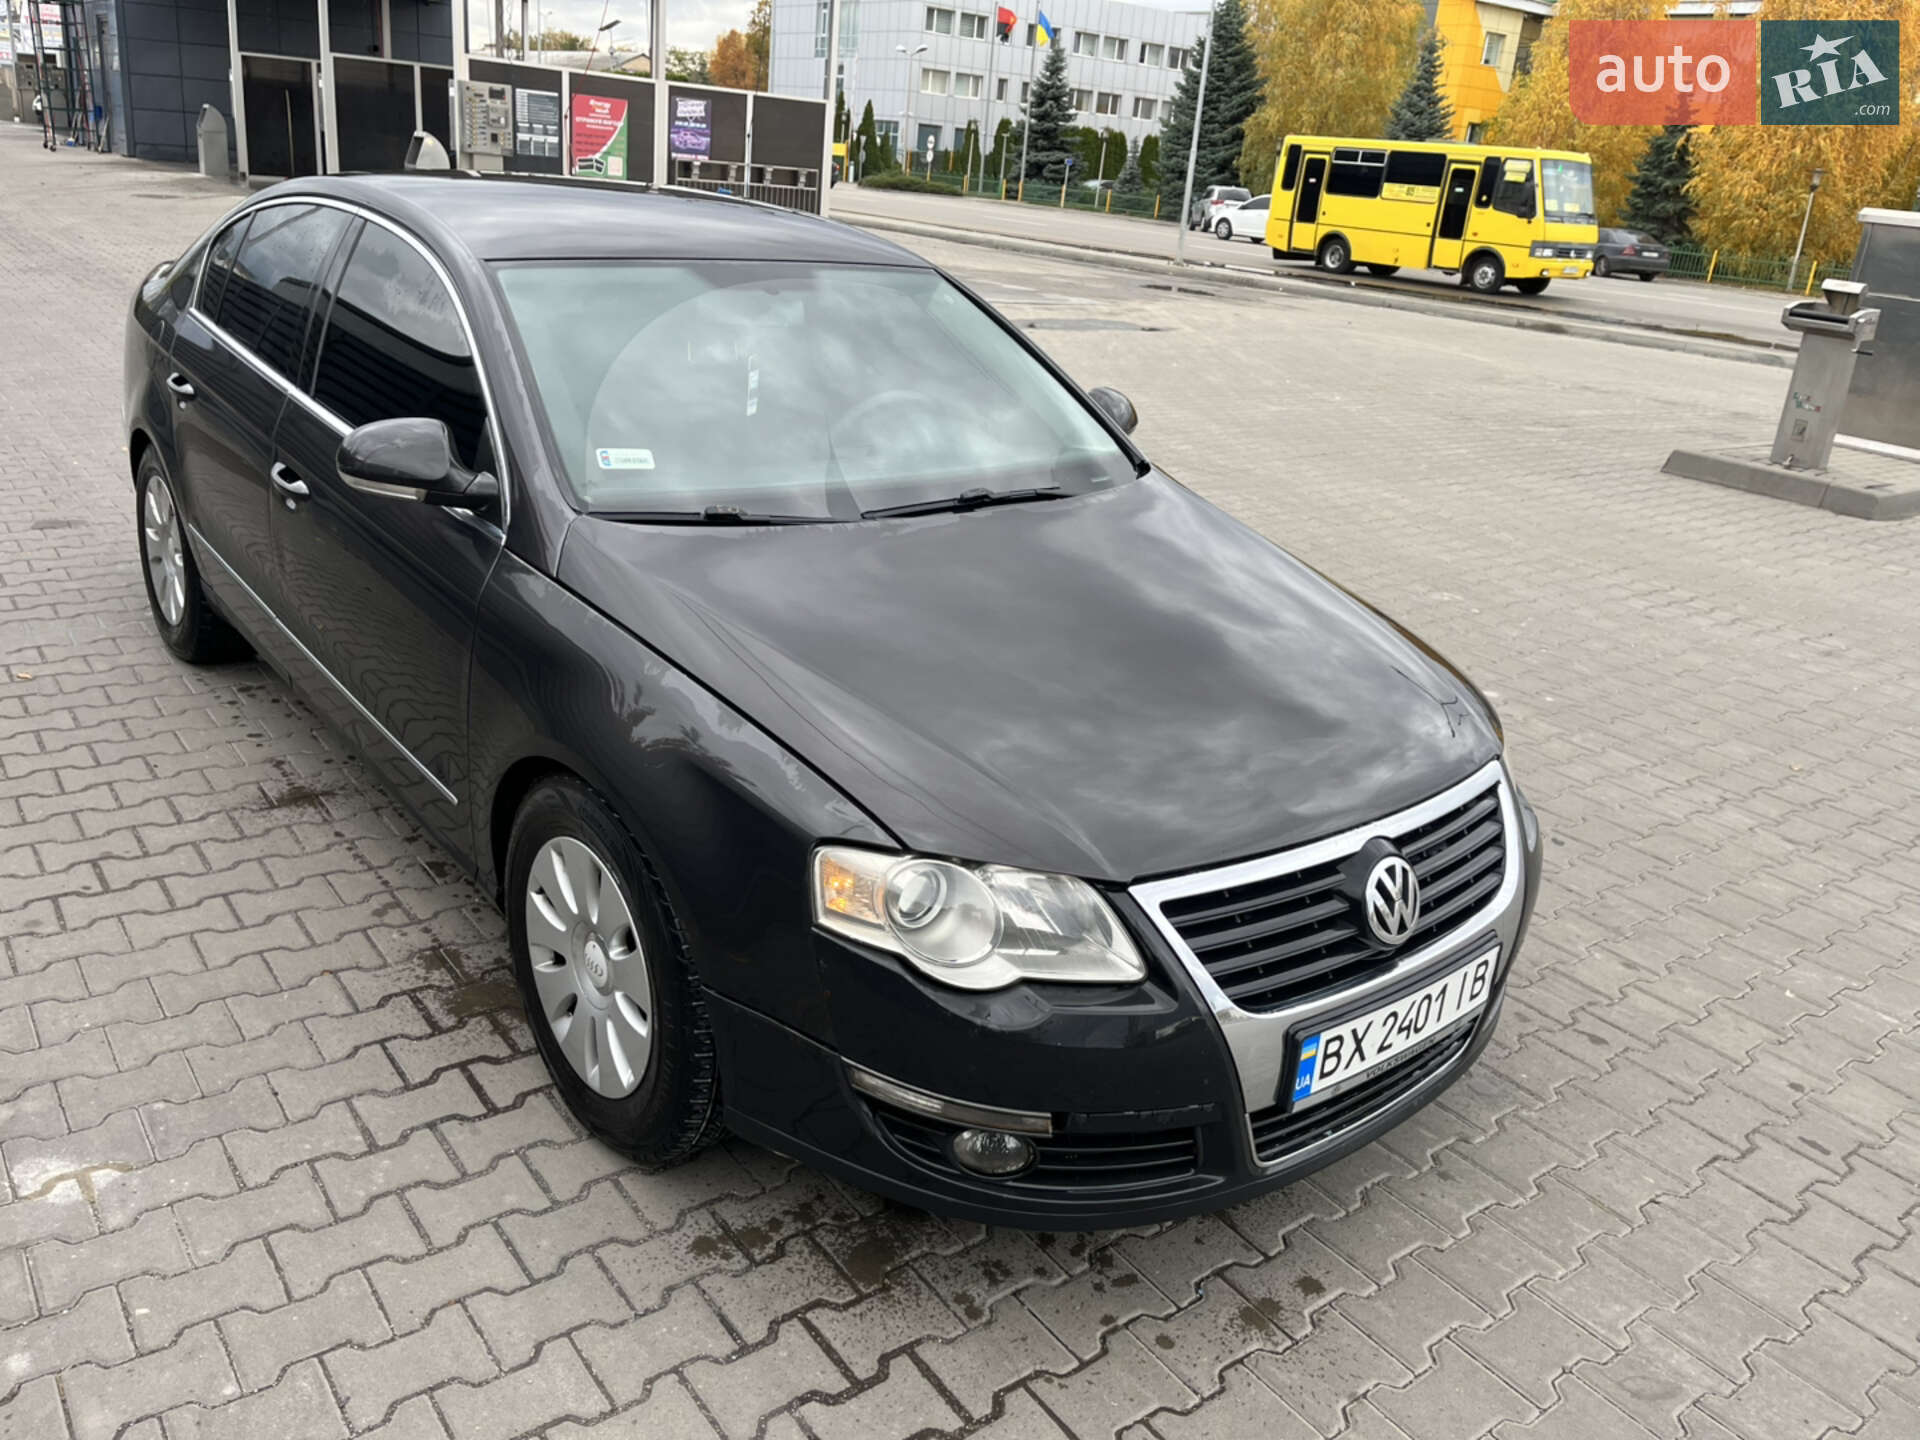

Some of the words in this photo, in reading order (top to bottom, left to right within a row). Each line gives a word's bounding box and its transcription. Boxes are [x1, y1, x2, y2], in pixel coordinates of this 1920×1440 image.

[1318, 1020, 1373, 1081] BX
[1377, 983, 1448, 1054] 2401
[1456, 959, 1489, 1011] IB
[1295, 1073, 1311, 1090] UA
